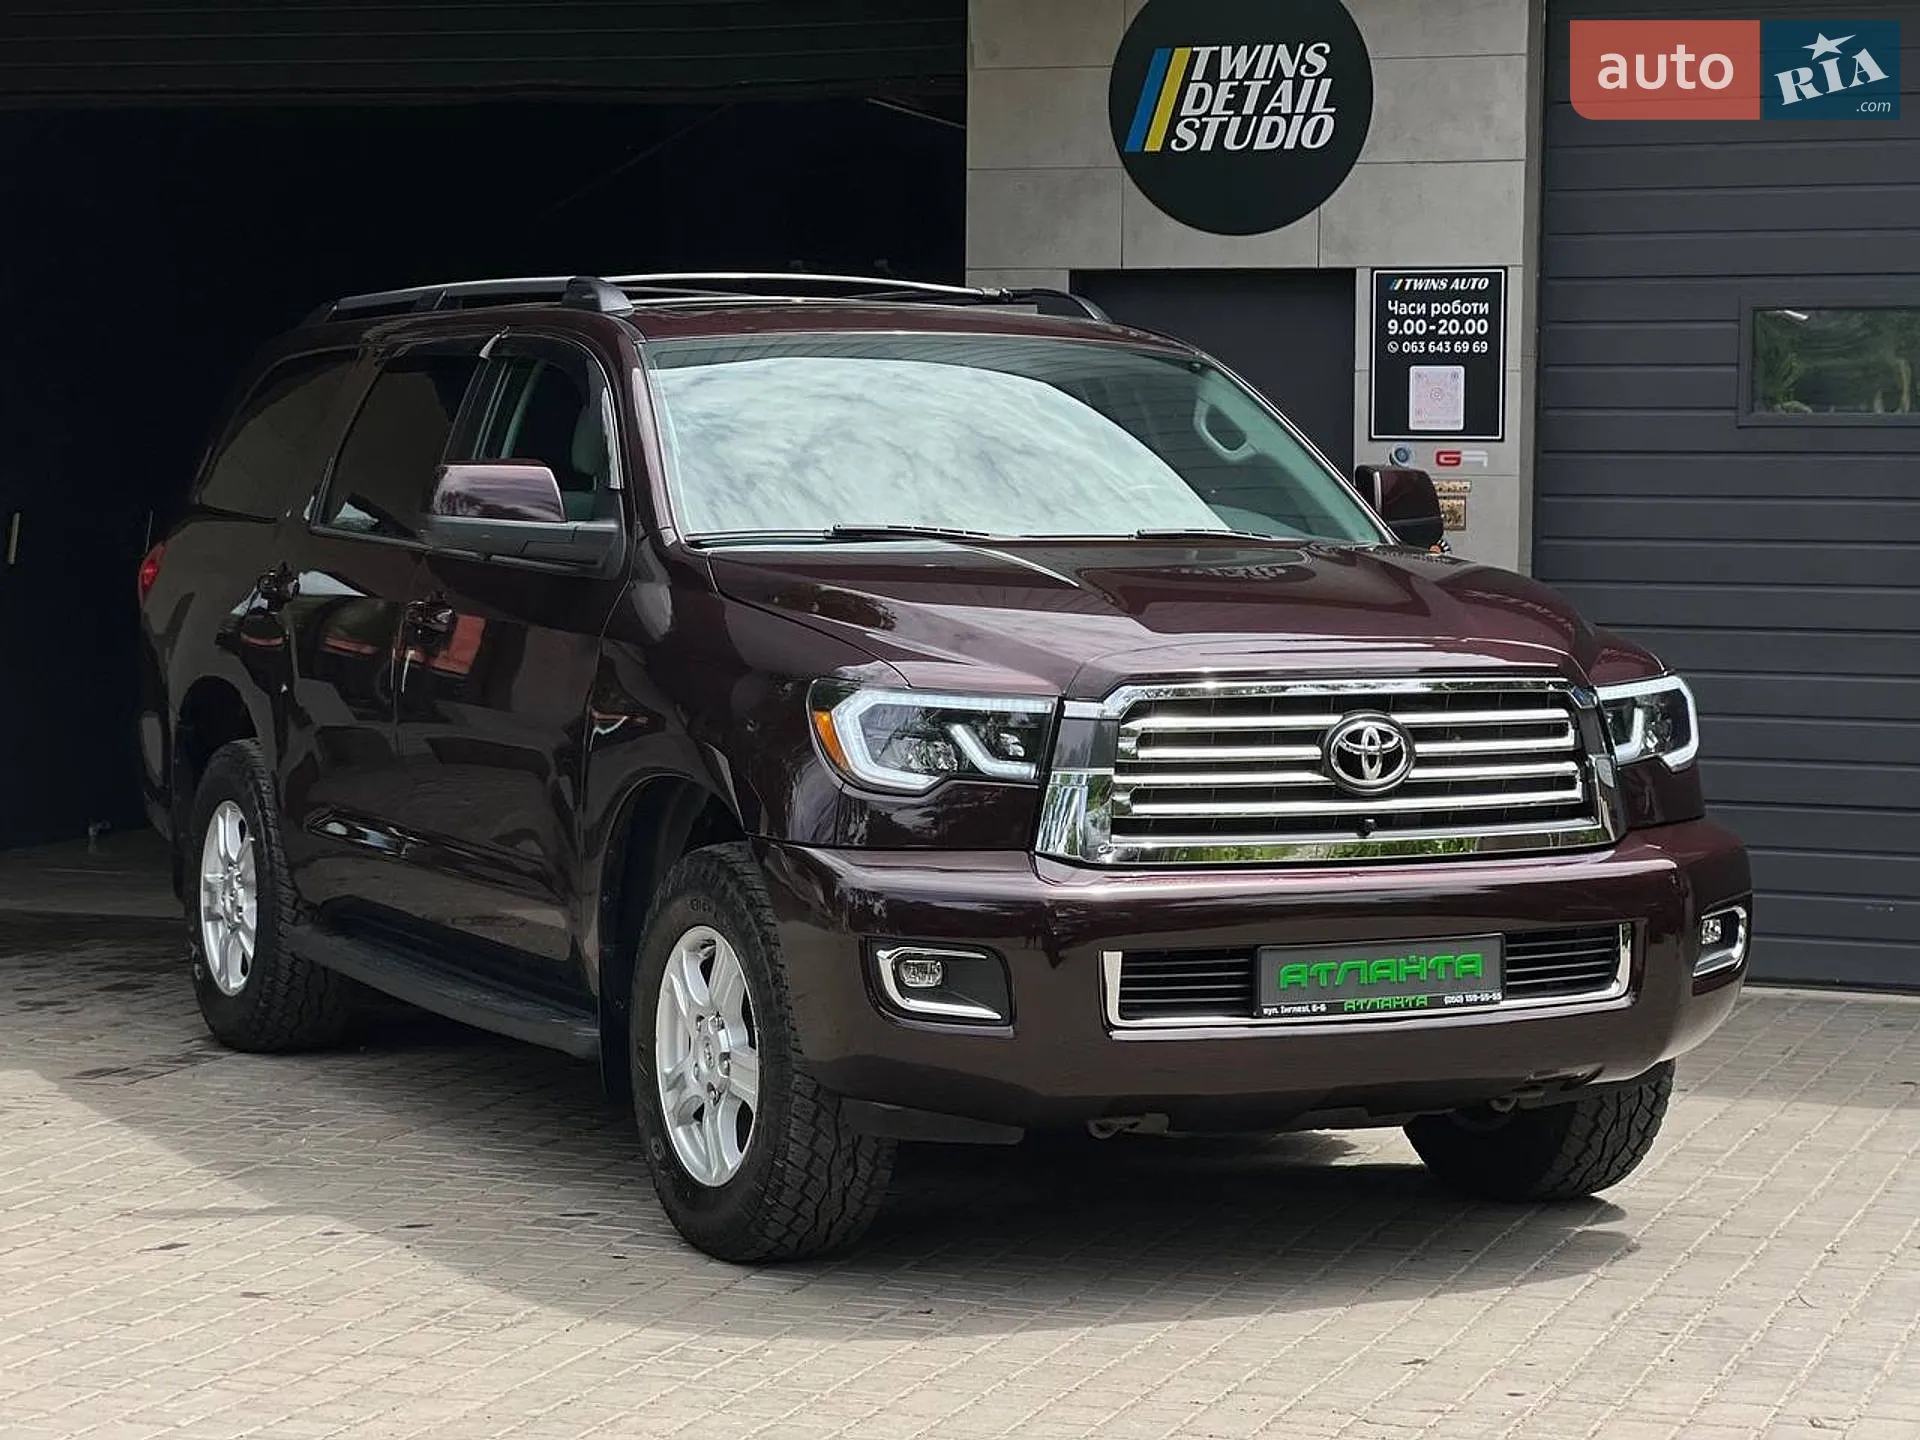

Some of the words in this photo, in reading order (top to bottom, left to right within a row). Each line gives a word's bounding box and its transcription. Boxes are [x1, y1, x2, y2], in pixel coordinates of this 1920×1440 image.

[1191, 42, 1331, 81] TWINS
[1180, 77, 1336, 116] DETAIL
[1171, 114, 1335, 152] STUDIO
[1404, 277, 1448, 291] TWINS
[1449, 277, 1490, 291] AUTO
[1387, 300, 1427, 315] Часи
[1431, 299, 1489, 318] роботи
[1387, 319, 1489, 336] 9.00-20.00
[1402, 341, 1426, 353] 063
[1428, 341, 1451, 353] 643
[1453, 341, 1470, 353] 69
[1472, 341, 1488, 353] 69
